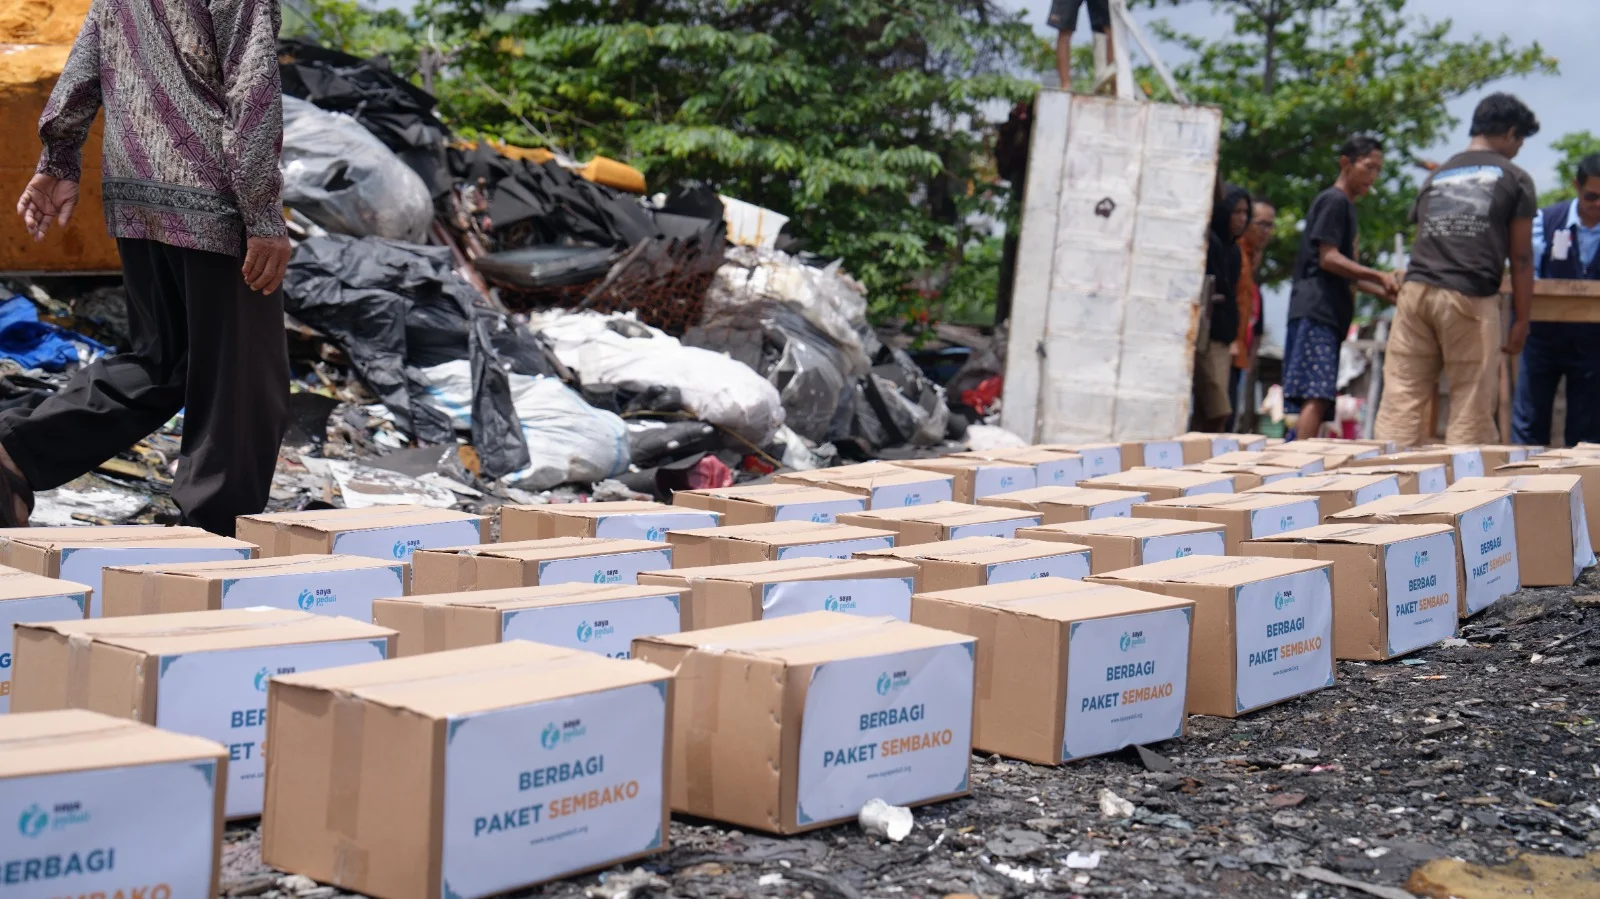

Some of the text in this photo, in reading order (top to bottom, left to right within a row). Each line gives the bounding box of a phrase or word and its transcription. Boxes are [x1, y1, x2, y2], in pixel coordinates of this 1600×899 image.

[1480, 536, 1502, 555] BERBAGI
[1472, 552, 1512, 579] PAKET SEMBAKO
[316, 588, 331, 596] saya
[1408, 575, 1437, 592] BERBAGI
[1395, 593, 1449, 617] PAKET SEMBAKO
[594, 620, 609, 628] saya
[1266, 617, 1305, 638] BERBAGI
[1249, 636, 1322, 667] PAKET SEMBAKO
[1106, 660, 1155, 681] BERBAGI
[1081, 682, 1173, 712] PAKET SEMBAKO
[859, 703, 925, 731] BERBAGI
[823, 729, 953, 768] PAKET SEMBAKO
[518, 754, 604, 791] BERBAGI
[474, 780, 639, 837] PAKET SEMBAKO
[0, 848, 115, 885] ERBAGI
